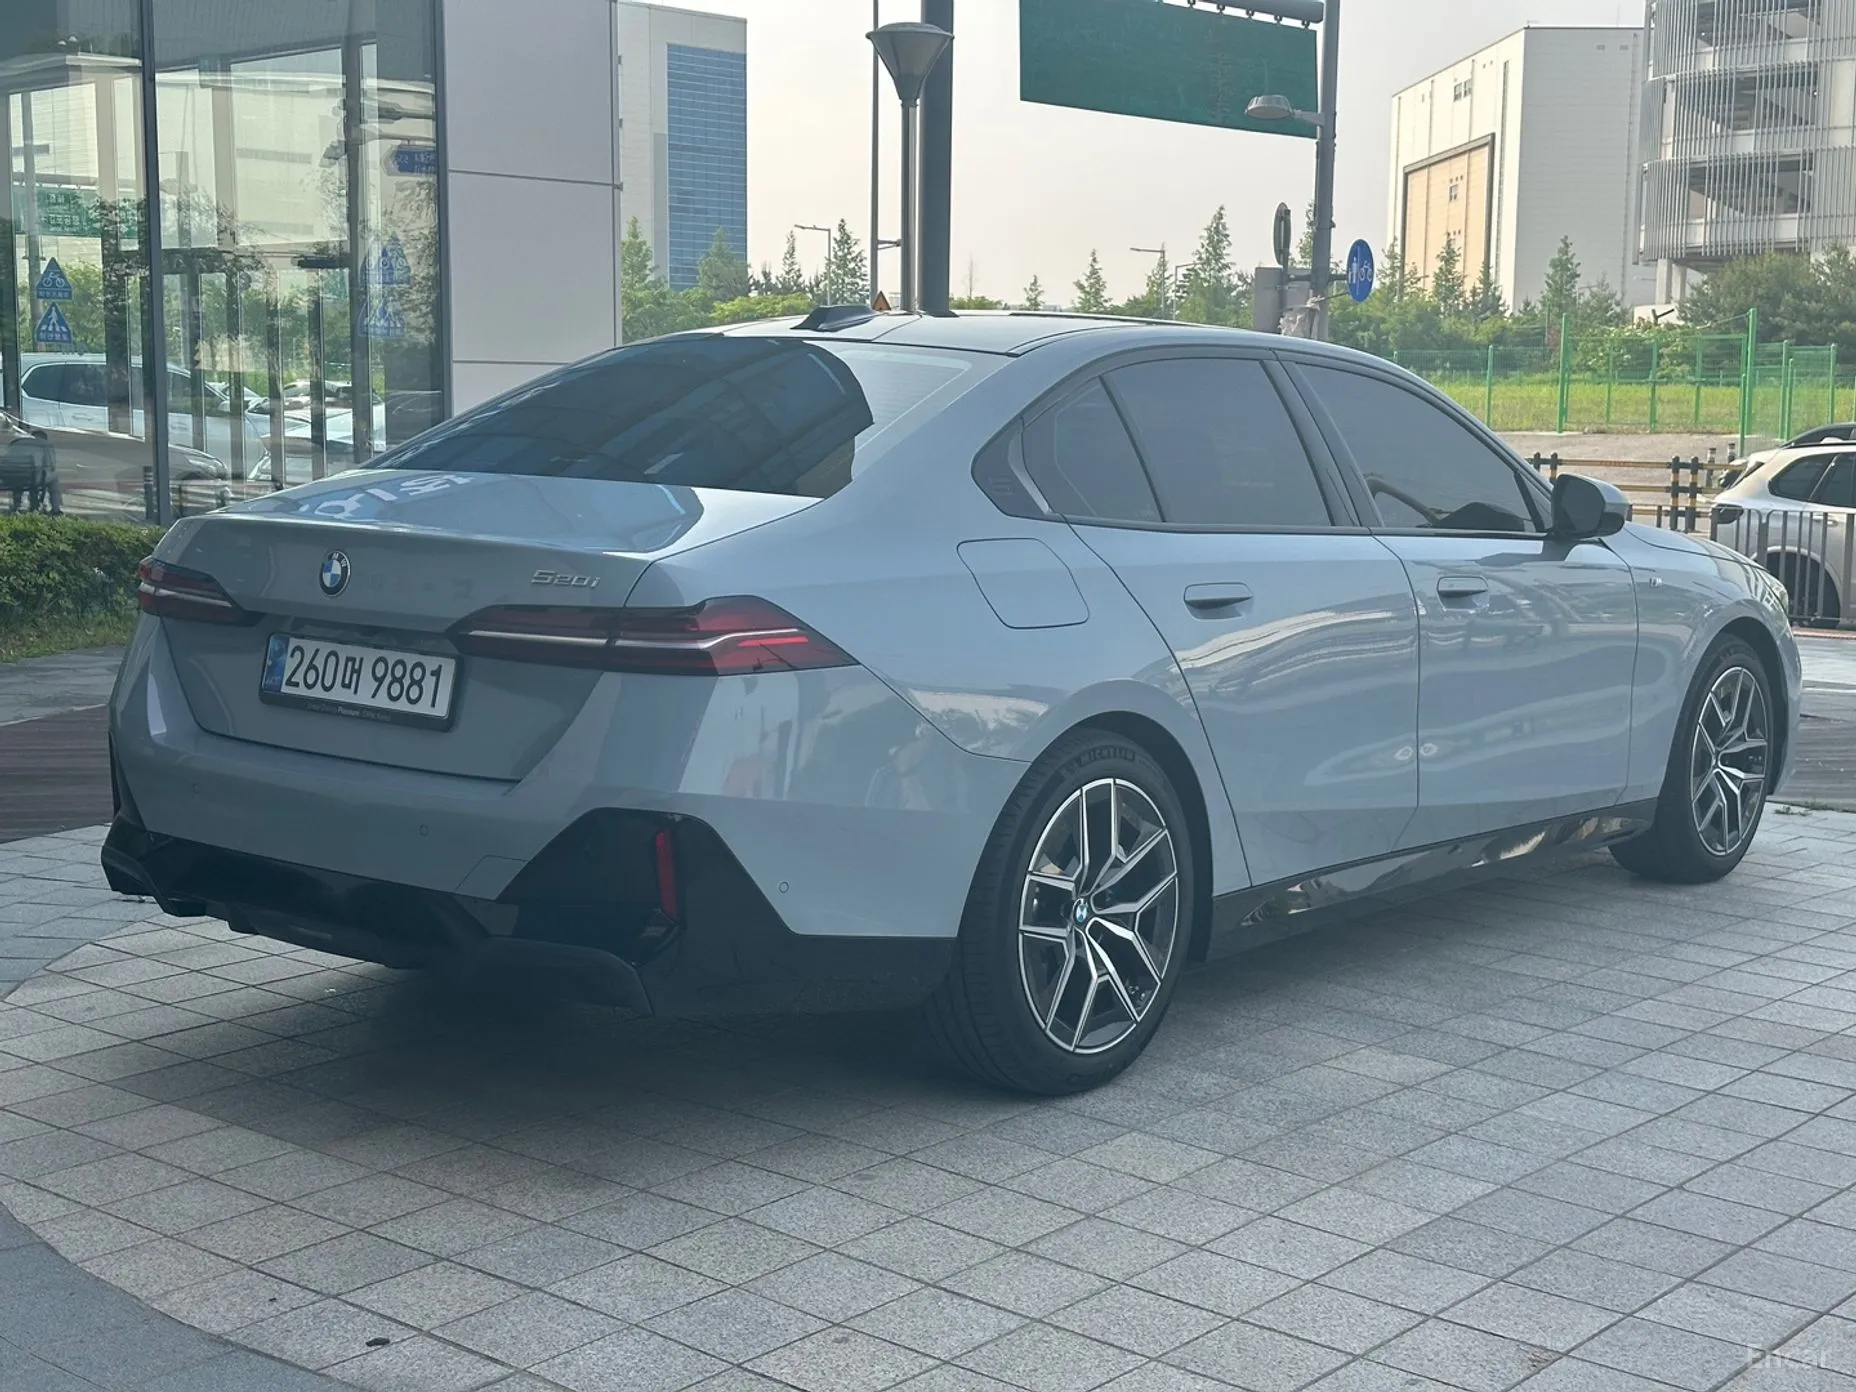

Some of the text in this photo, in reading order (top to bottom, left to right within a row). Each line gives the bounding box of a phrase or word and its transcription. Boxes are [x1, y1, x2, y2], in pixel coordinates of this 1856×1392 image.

[530, 569, 600, 587] 520i
[285, 645, 442, 708] 260머 9881
